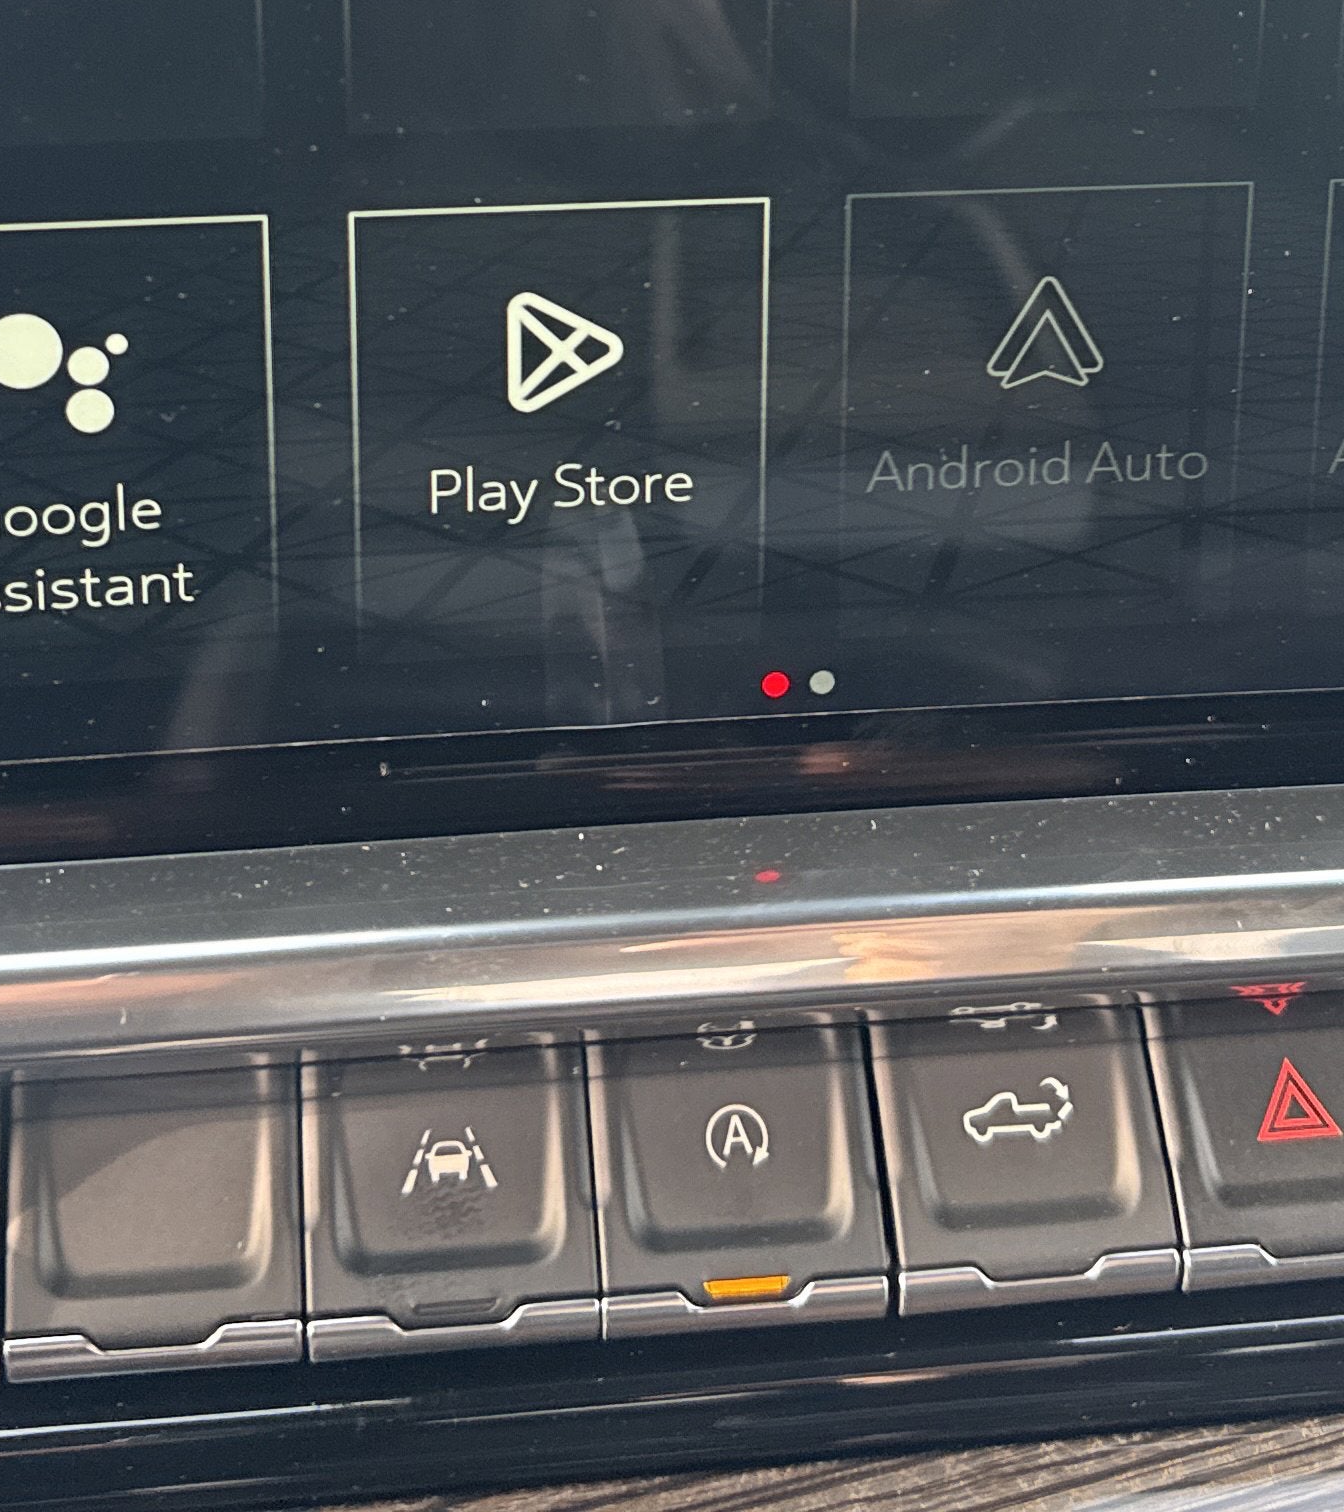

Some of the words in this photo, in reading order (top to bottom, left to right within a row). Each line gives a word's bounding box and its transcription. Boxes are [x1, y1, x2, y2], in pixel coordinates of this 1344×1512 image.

[431, 466, 538, 524] Play
[554, 464, 693, 507] Store
[866, 441, 1070, 492] Android
[1085, 442, 1207, 483] Auto
